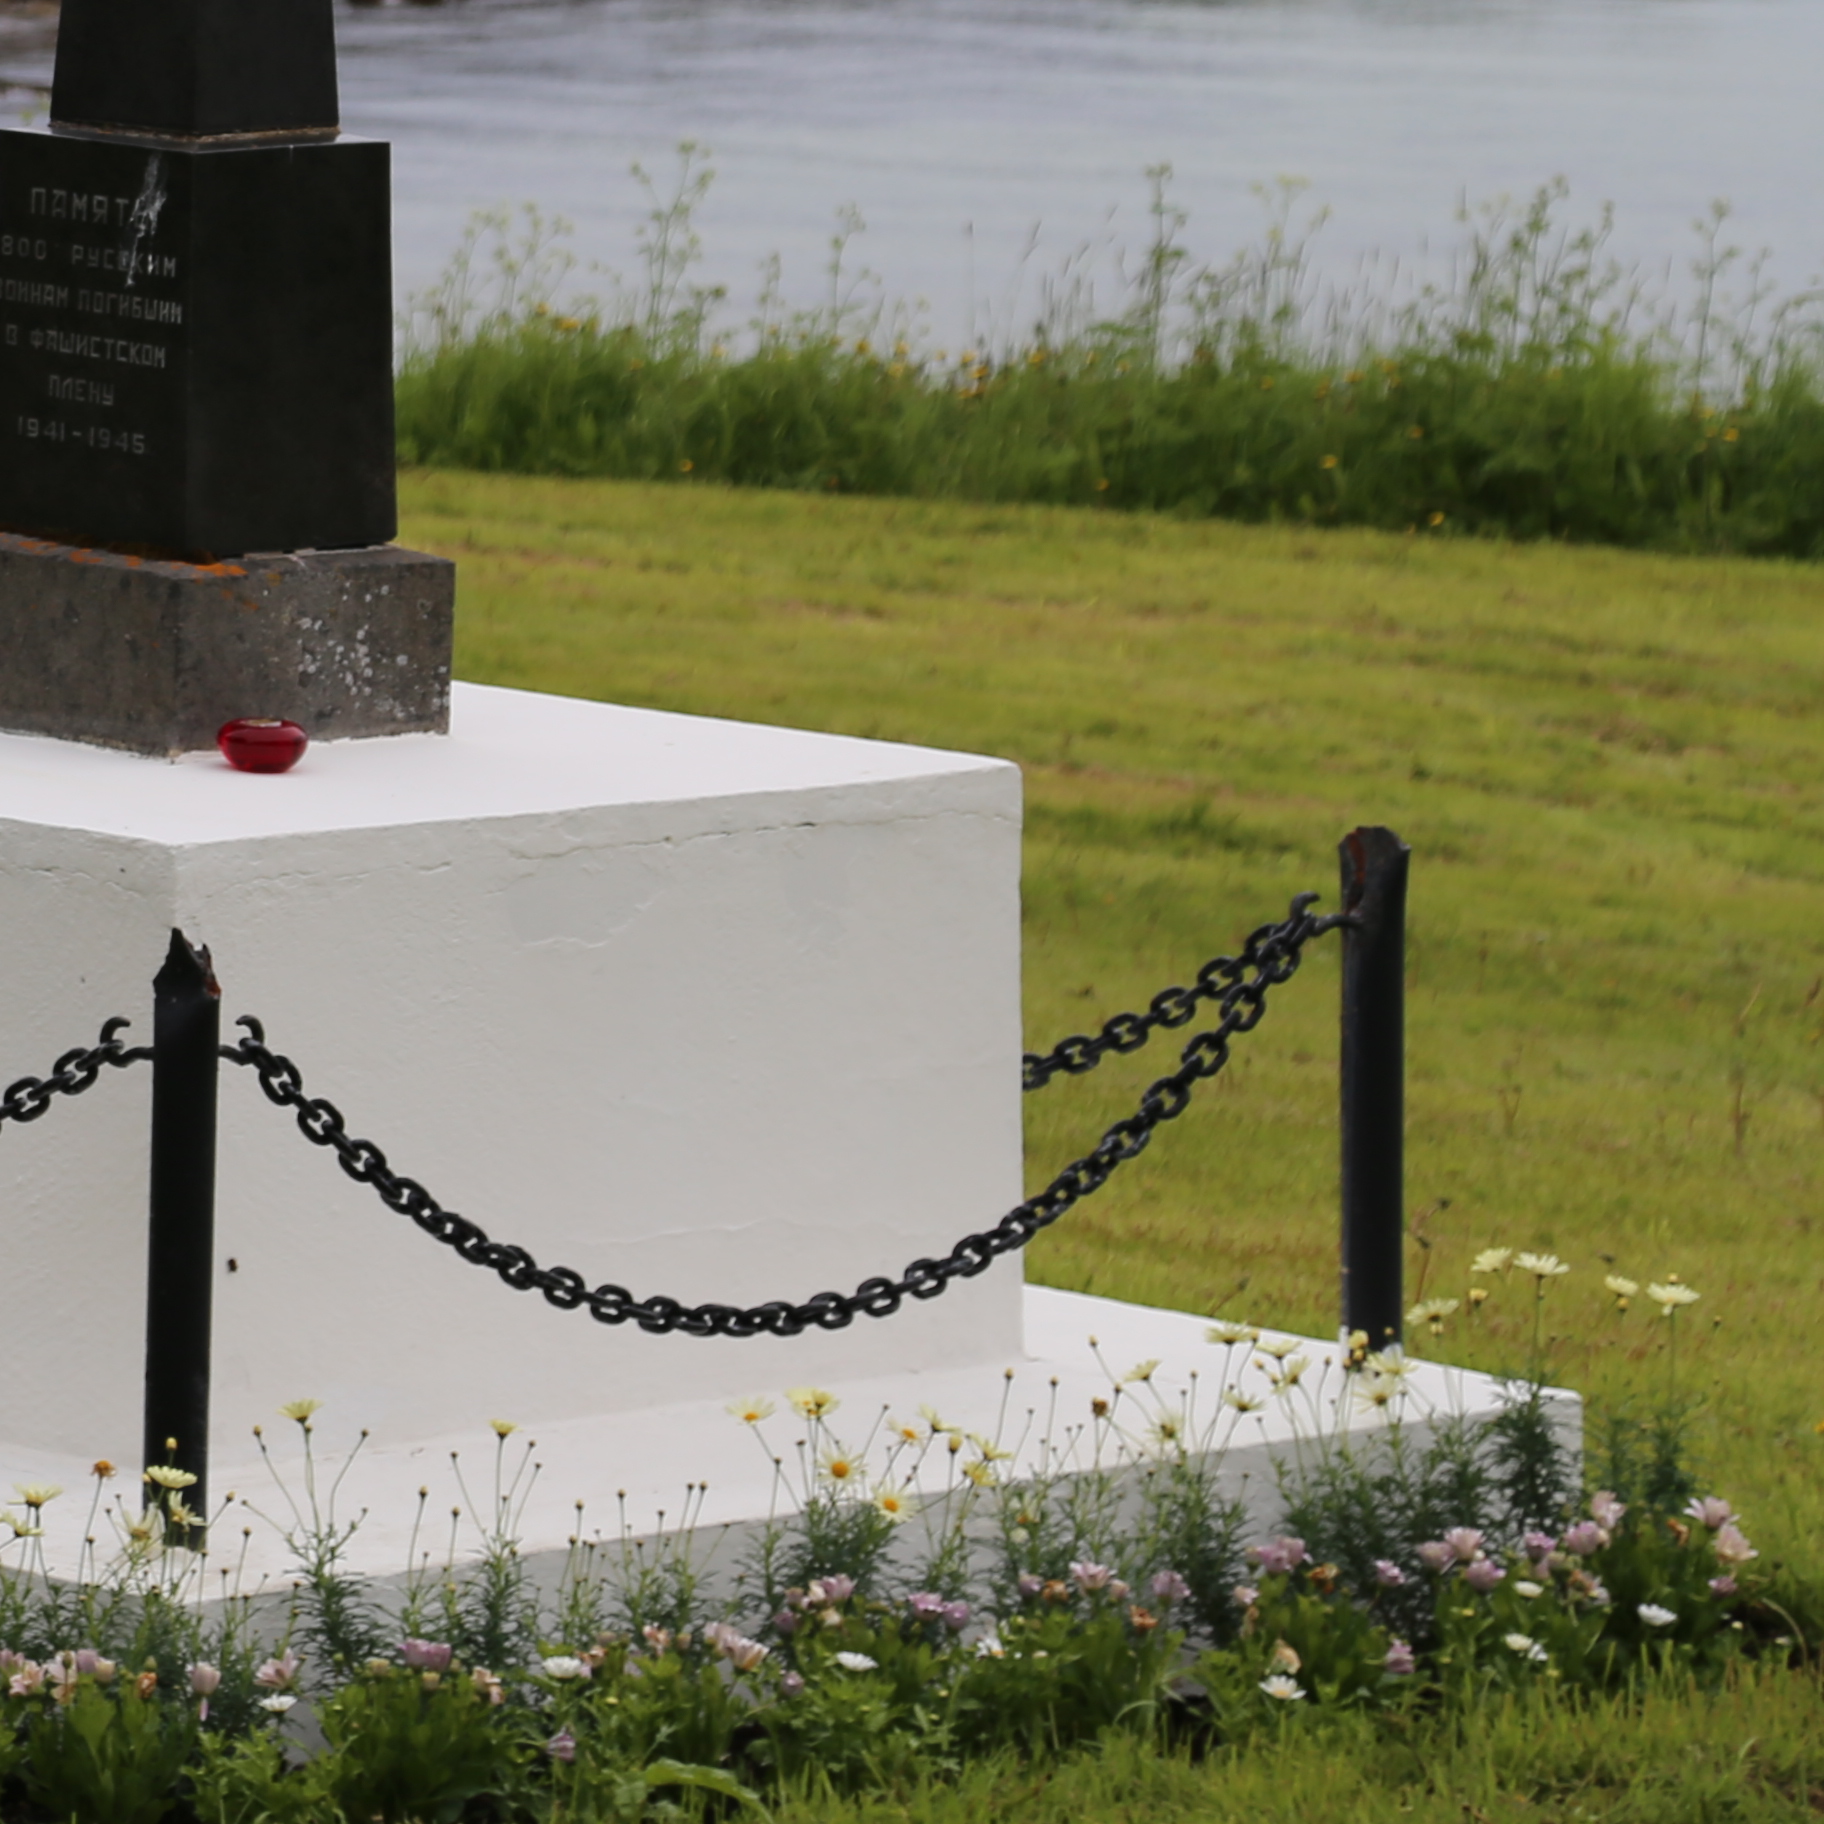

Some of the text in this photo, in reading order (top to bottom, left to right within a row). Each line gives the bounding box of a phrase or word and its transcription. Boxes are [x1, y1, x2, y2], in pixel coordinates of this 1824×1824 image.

[1, 235, 47, 260] 800
[5, 324, 166, 368] В ФАШИСТСКОМ
[48, 375, 115, 407] ПЛЕНУ
[17, 415, 146, 455] 1941-1945
